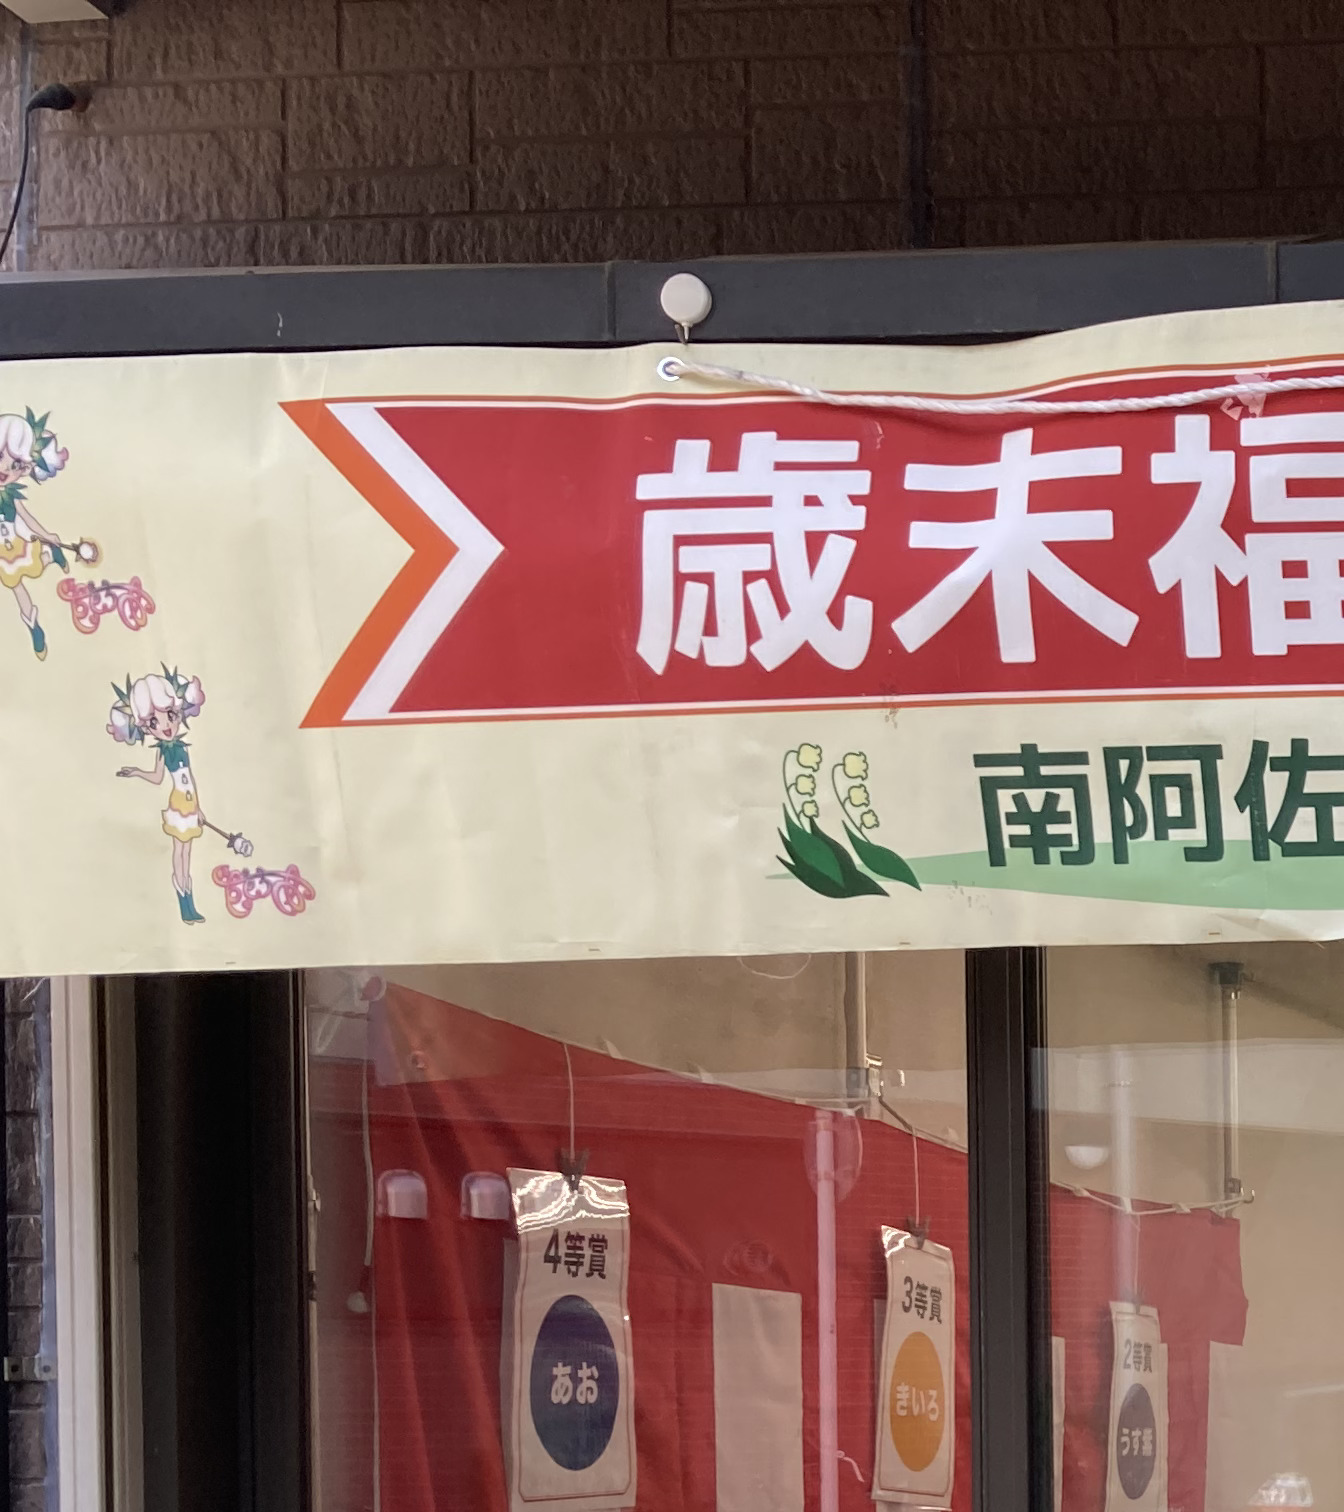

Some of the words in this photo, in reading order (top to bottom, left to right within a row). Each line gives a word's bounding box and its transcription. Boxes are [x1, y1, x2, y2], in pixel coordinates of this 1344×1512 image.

[543, 1228, 608, 1279] 4等賞
[902, 1276, 942, 1325] 3等賞
[1123, 1338, 1152, 1373] 2等賞
[551, 1361, 599, 1405] あお
[896, 1382, 939, 1421] きいろ
